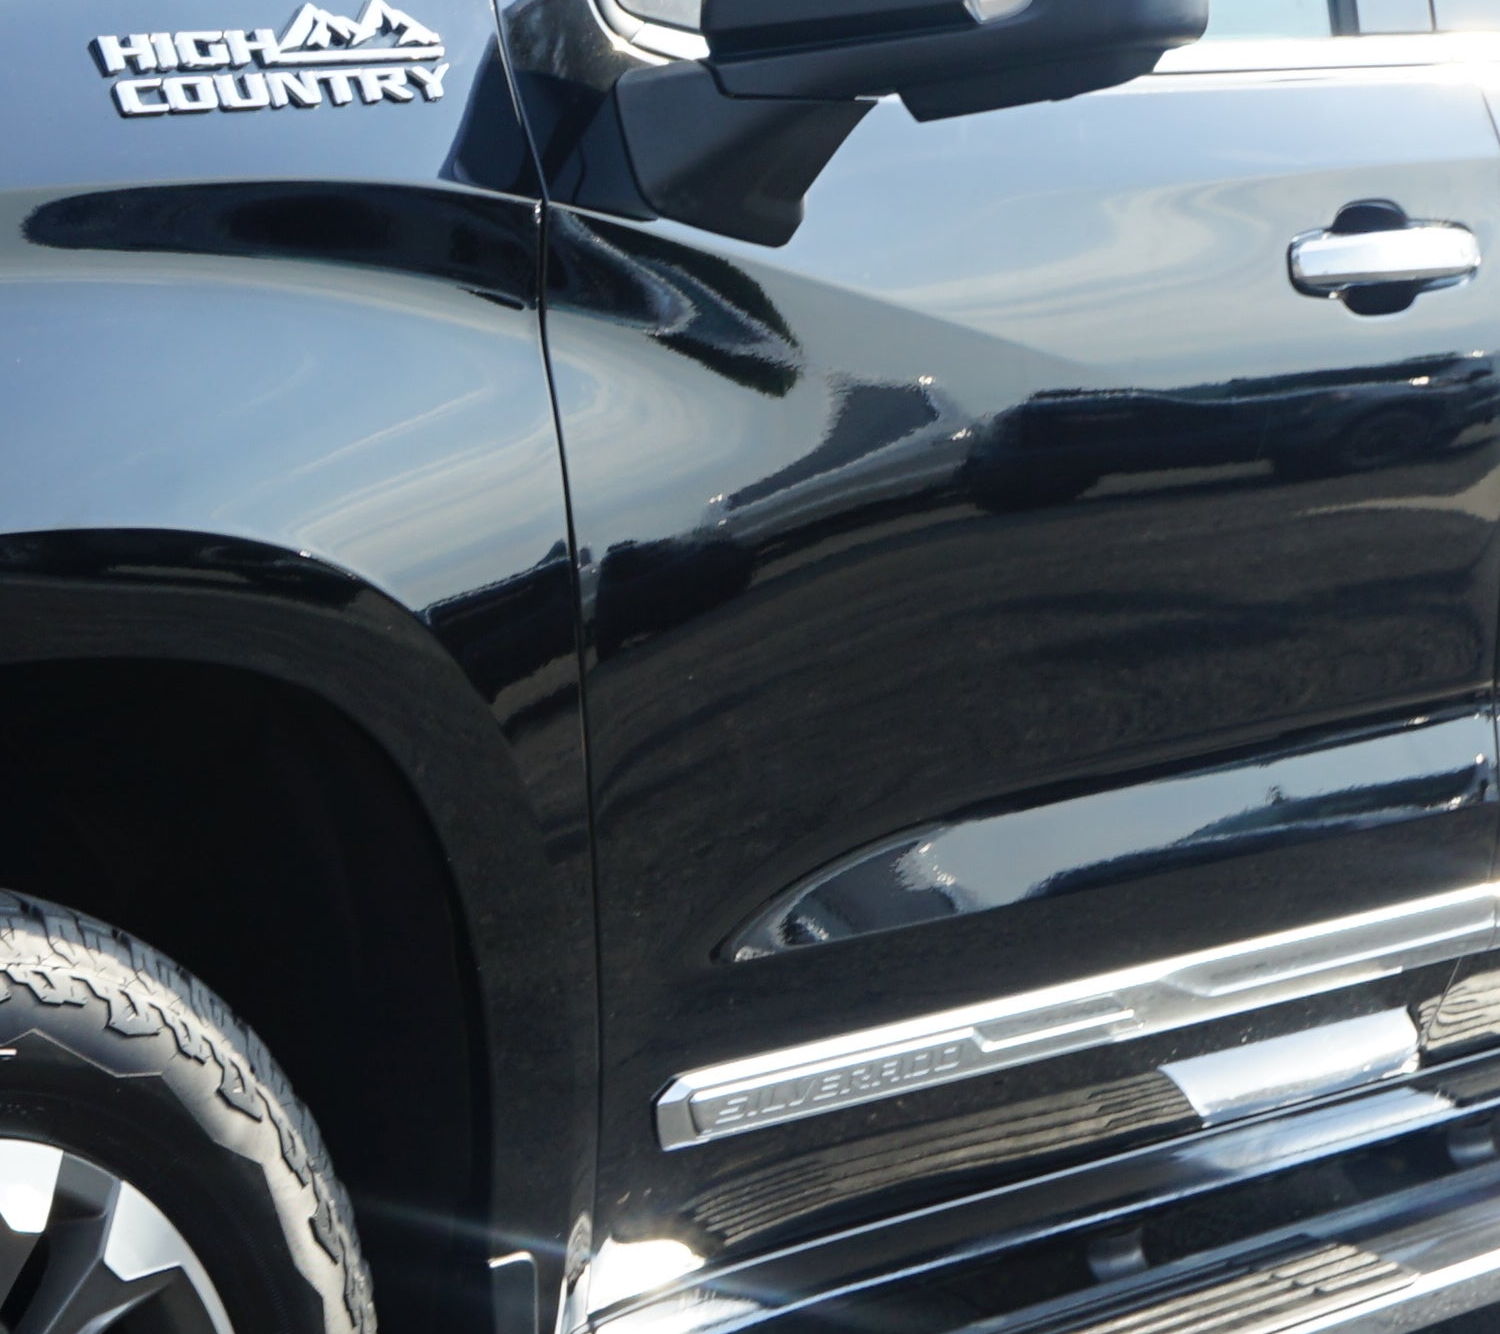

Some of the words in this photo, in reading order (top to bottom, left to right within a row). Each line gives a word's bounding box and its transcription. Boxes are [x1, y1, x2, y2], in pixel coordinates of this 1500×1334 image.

[89, 29, 281, 76] HIGH
[112, 63, 450, 118] COUNTRY
[717, 1045, 963, 1123] SILVERADO
